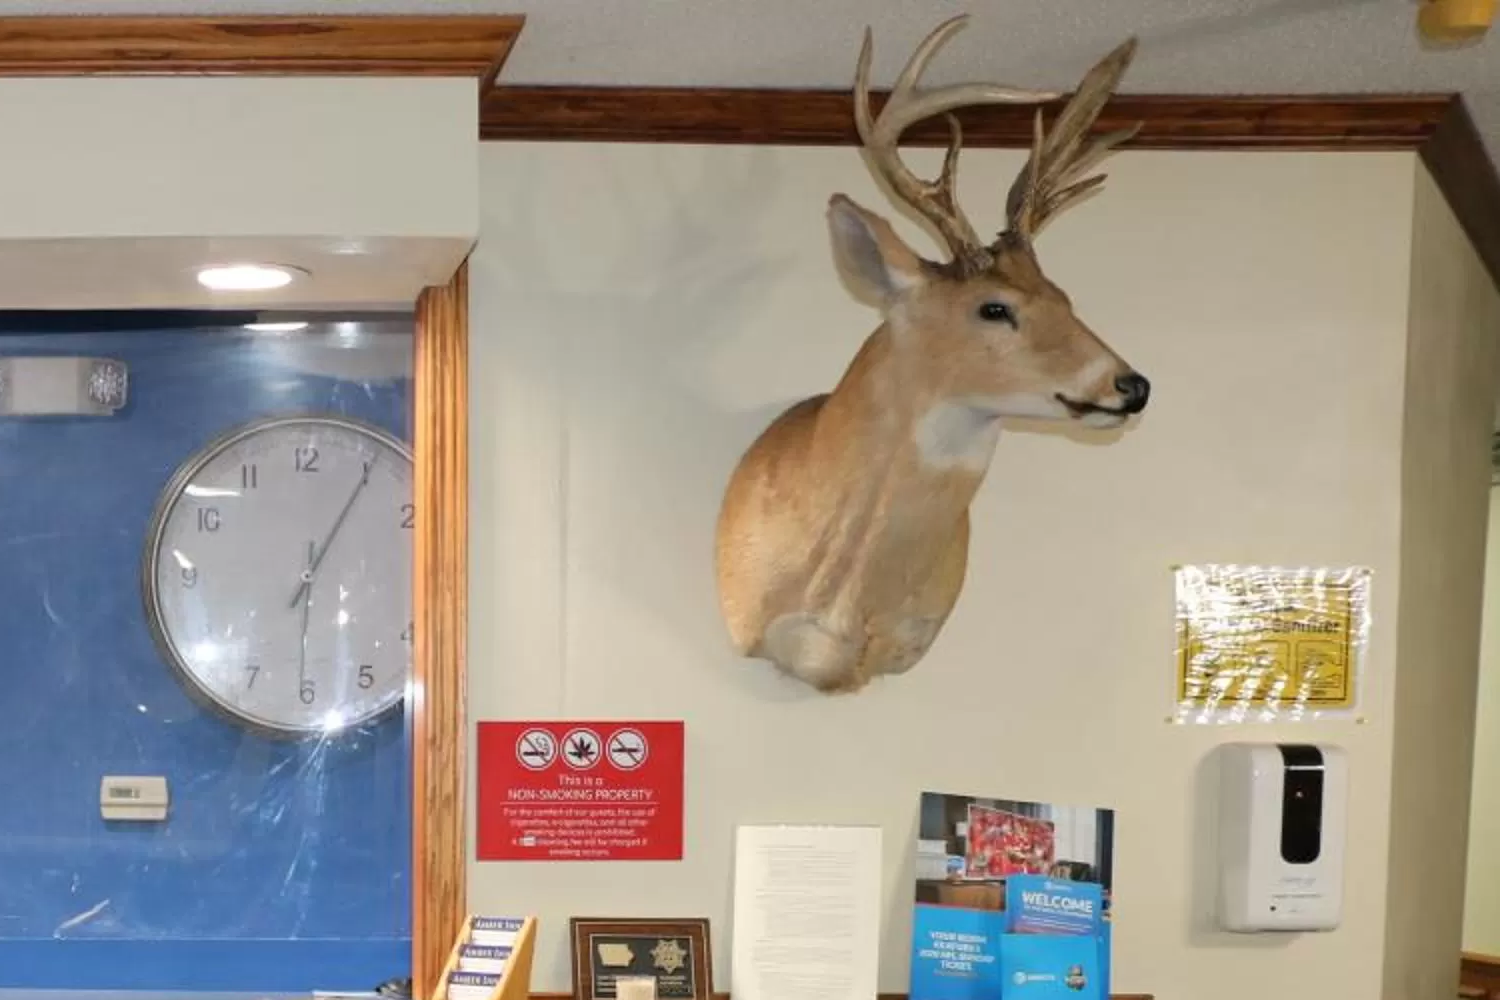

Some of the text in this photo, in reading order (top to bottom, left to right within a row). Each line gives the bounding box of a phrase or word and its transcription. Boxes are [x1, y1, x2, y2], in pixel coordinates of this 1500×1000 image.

[295, 447, 320, 473] 12
[241, 464, 257, 489] 11
[197, 507, 221, 532] 10
[400, 503, 415, 529] 2
[181, 566, 198, 589] 9
[245, 665, 260, 688] 7
[357, 664, 374, 689] 5
[300, 679, 315, 704] 6
[558, 775, 603, 786] This is a
[507, 789, 652, 801] NON-SMOKING PROPERTY
[1021, 891, 1093, 913] WELCOME
